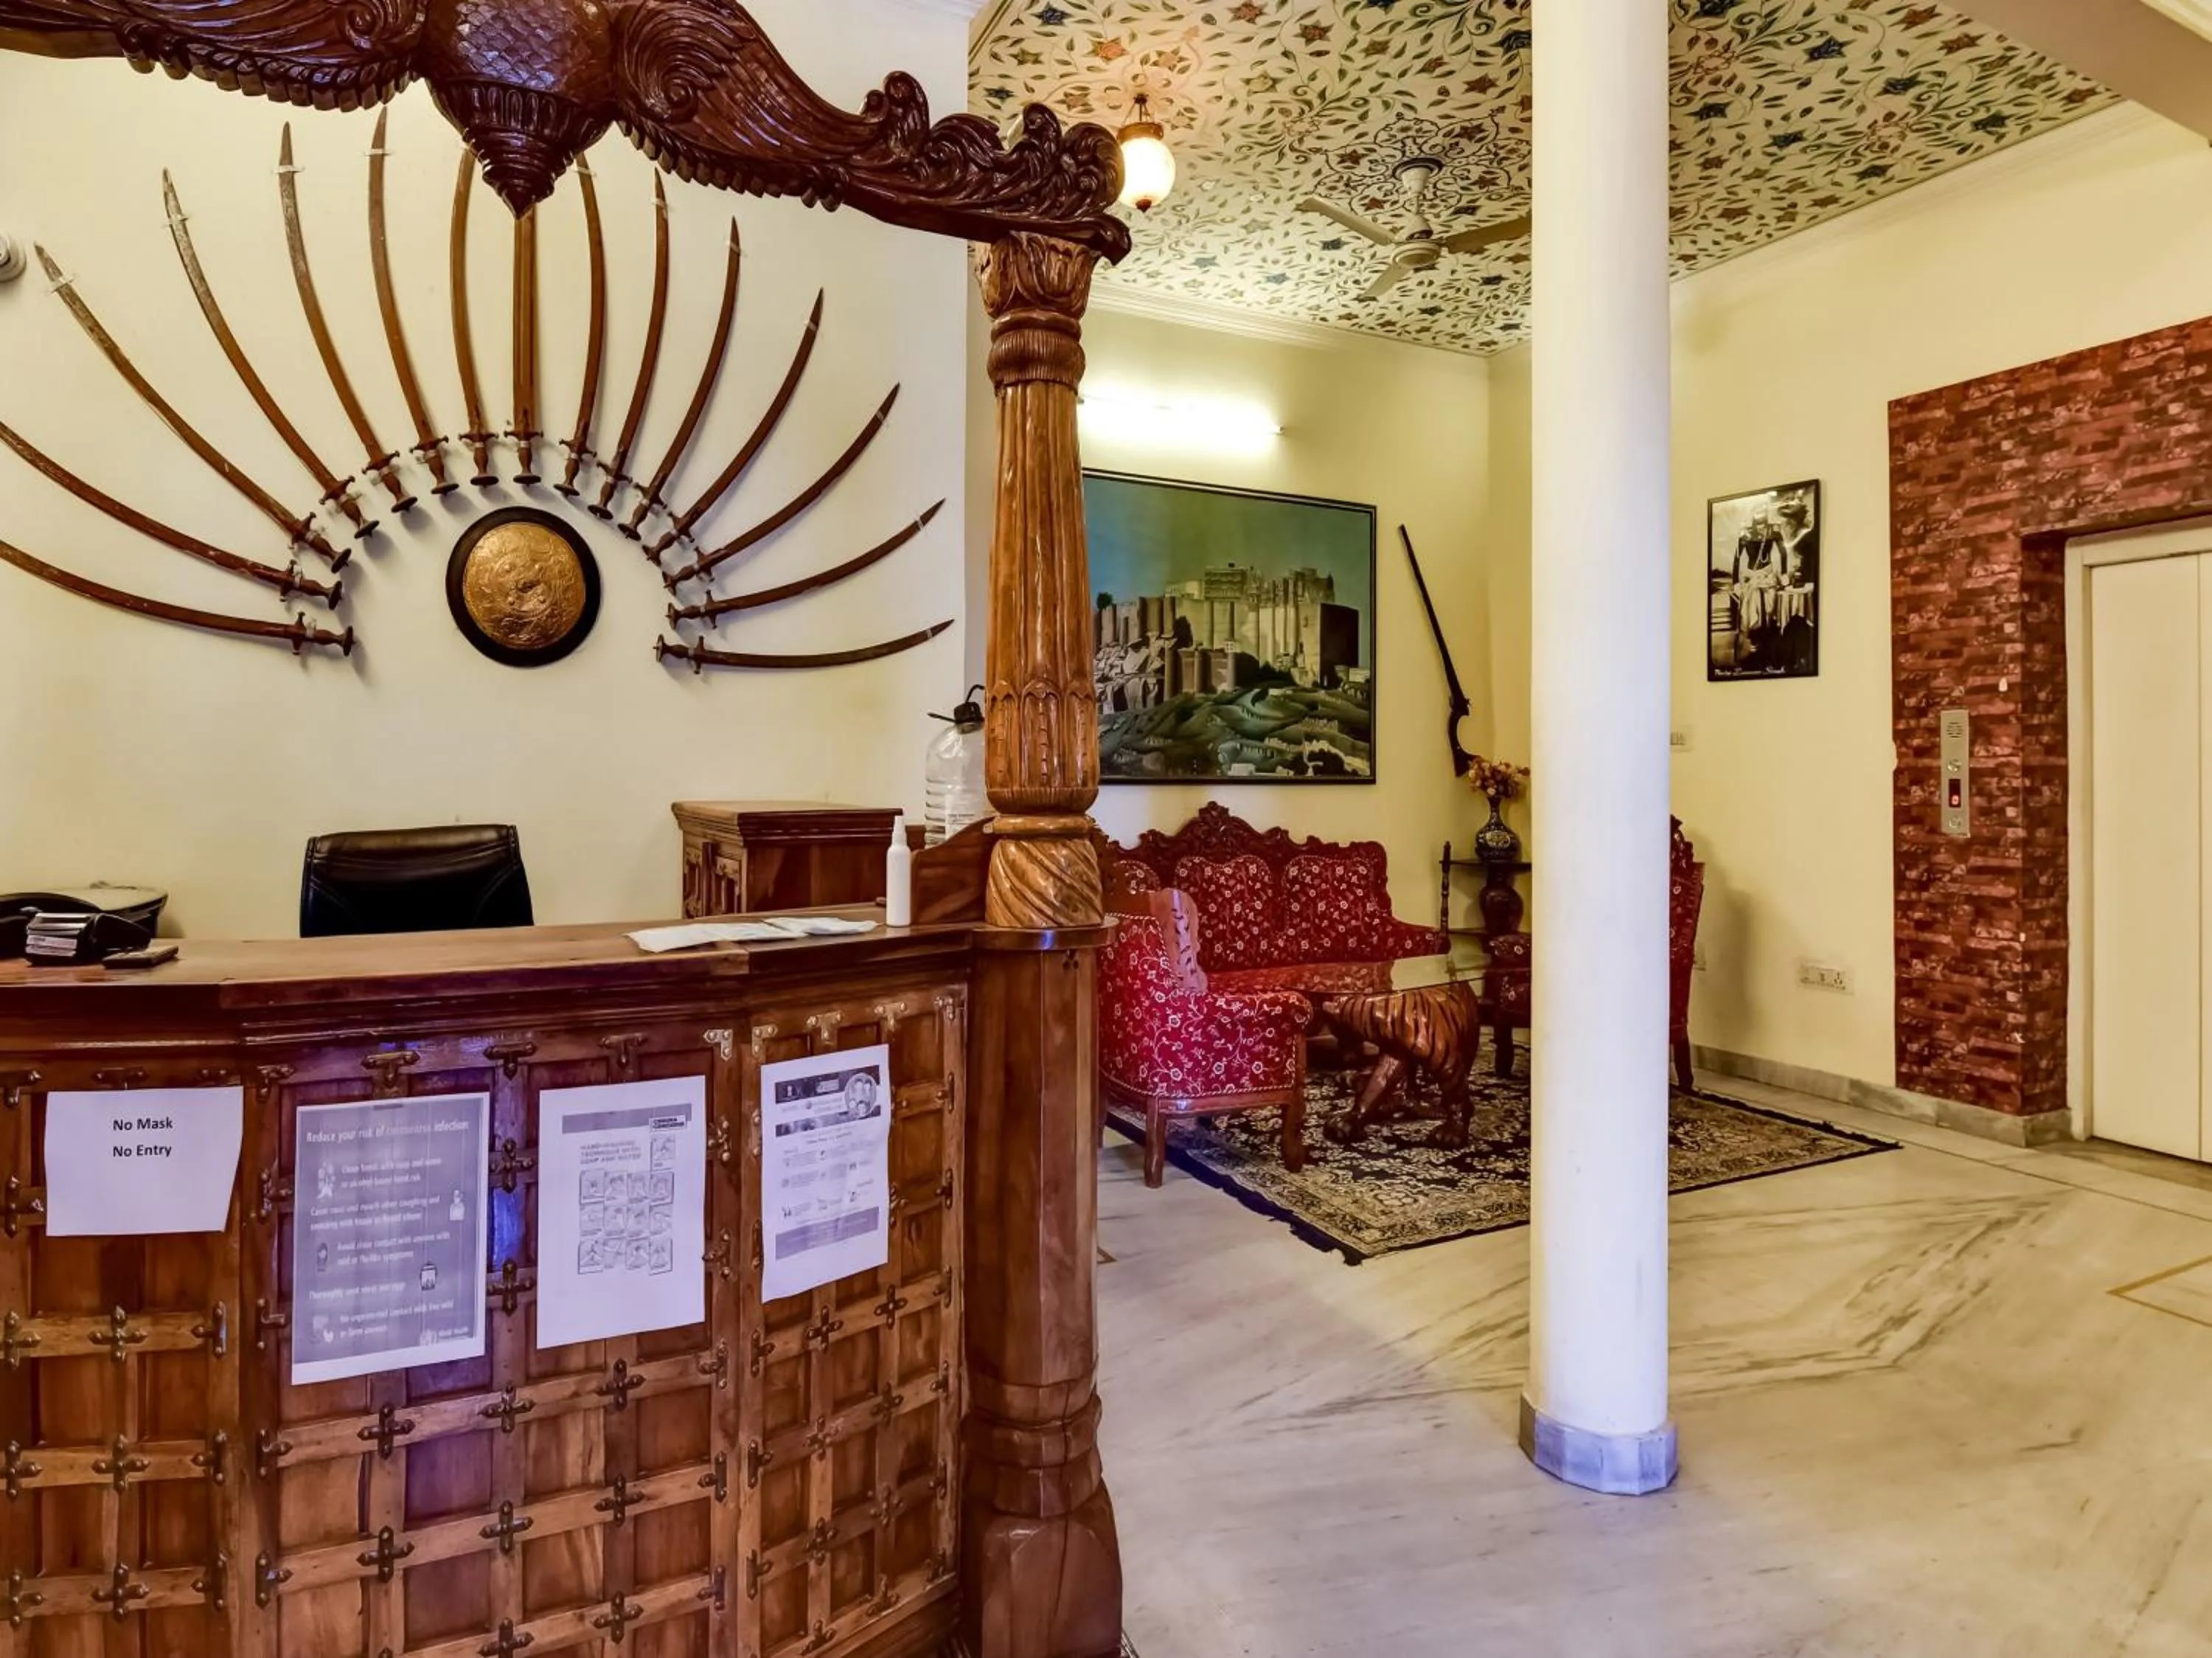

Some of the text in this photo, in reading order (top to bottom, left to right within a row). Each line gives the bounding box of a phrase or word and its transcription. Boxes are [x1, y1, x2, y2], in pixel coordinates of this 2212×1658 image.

[113, 1116, 173, 1131] No Mask
[113, 1144, 172, 1157] No Entry
